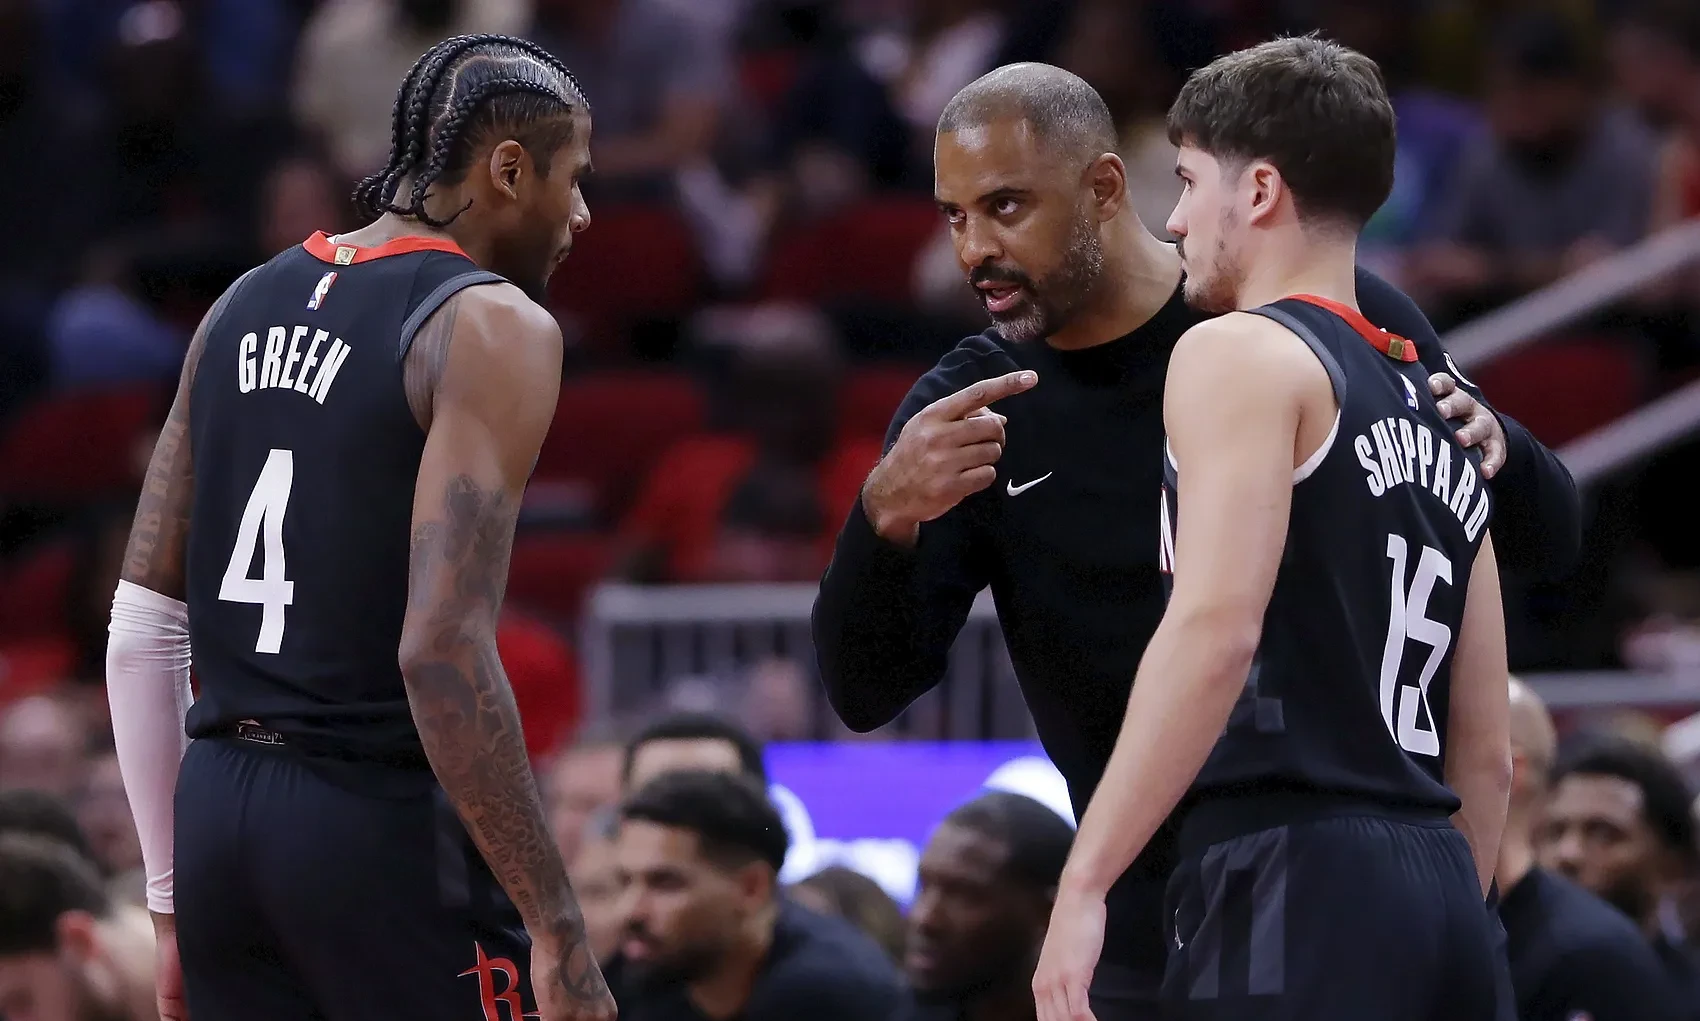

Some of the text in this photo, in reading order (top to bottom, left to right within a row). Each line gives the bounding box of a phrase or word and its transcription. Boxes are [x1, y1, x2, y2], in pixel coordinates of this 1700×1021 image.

[238, 325, 352, 405] GREEN
[217, 448, 295, 654] 4
[1354, 417, 1490, 543] SHEPPARD
[1380, 532, 1453, 757] 15
